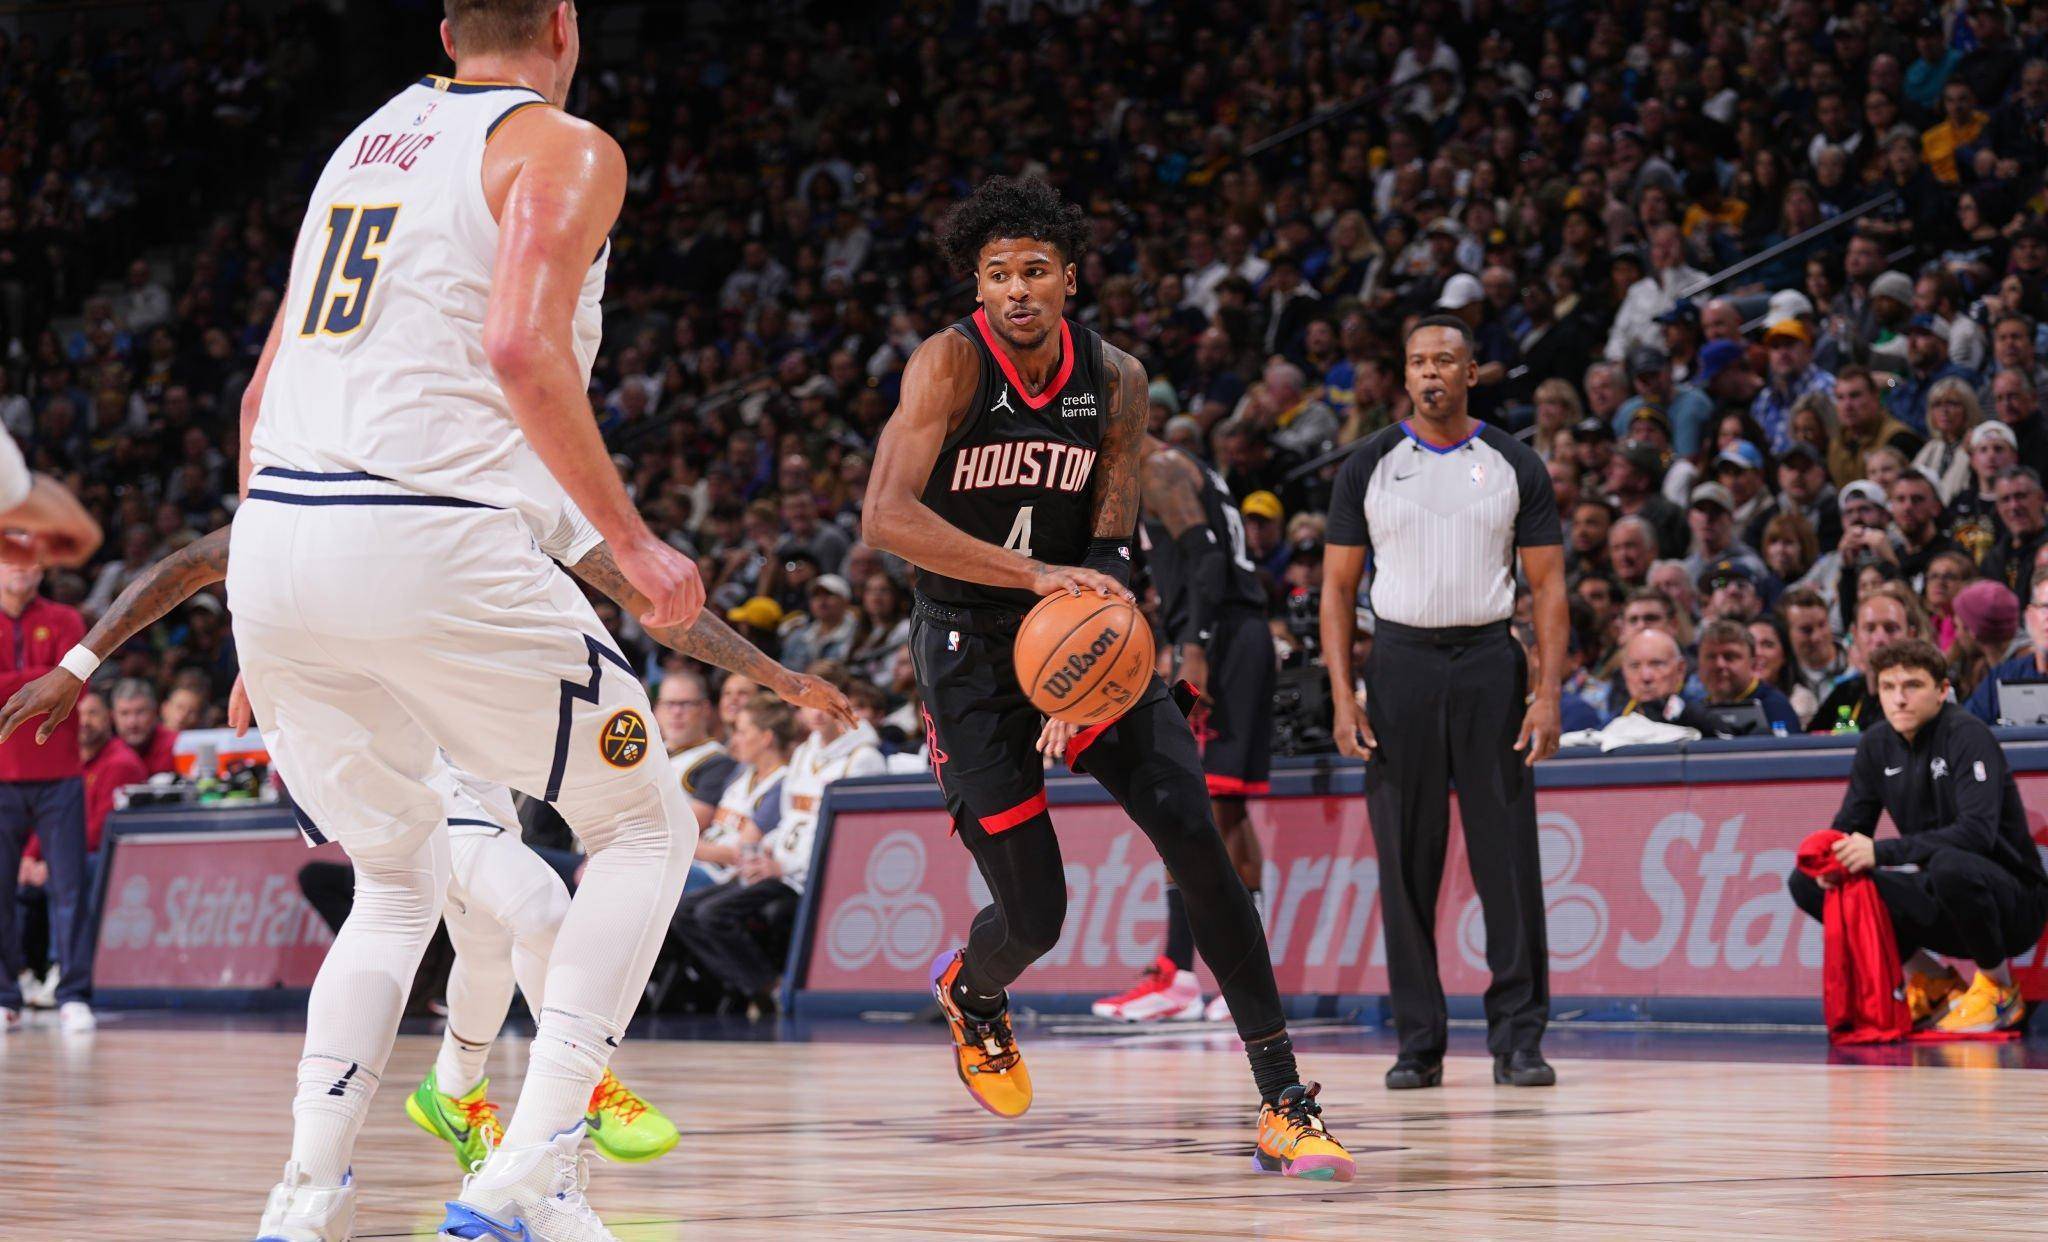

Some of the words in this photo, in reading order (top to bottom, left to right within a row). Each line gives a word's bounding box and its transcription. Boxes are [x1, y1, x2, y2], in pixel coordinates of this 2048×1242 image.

[349, 131, 441, 172] JOKIĆ
[298, 202, 402, 339] 15
[1061, 405, 1097, 418] karma
[1062, 392, 1096, 406] credit
[950, 441, 1097, 493] HOUSTON
[1002, 505, 1034, 557] 4
[1042, 627, 1120, 700] Wilson
